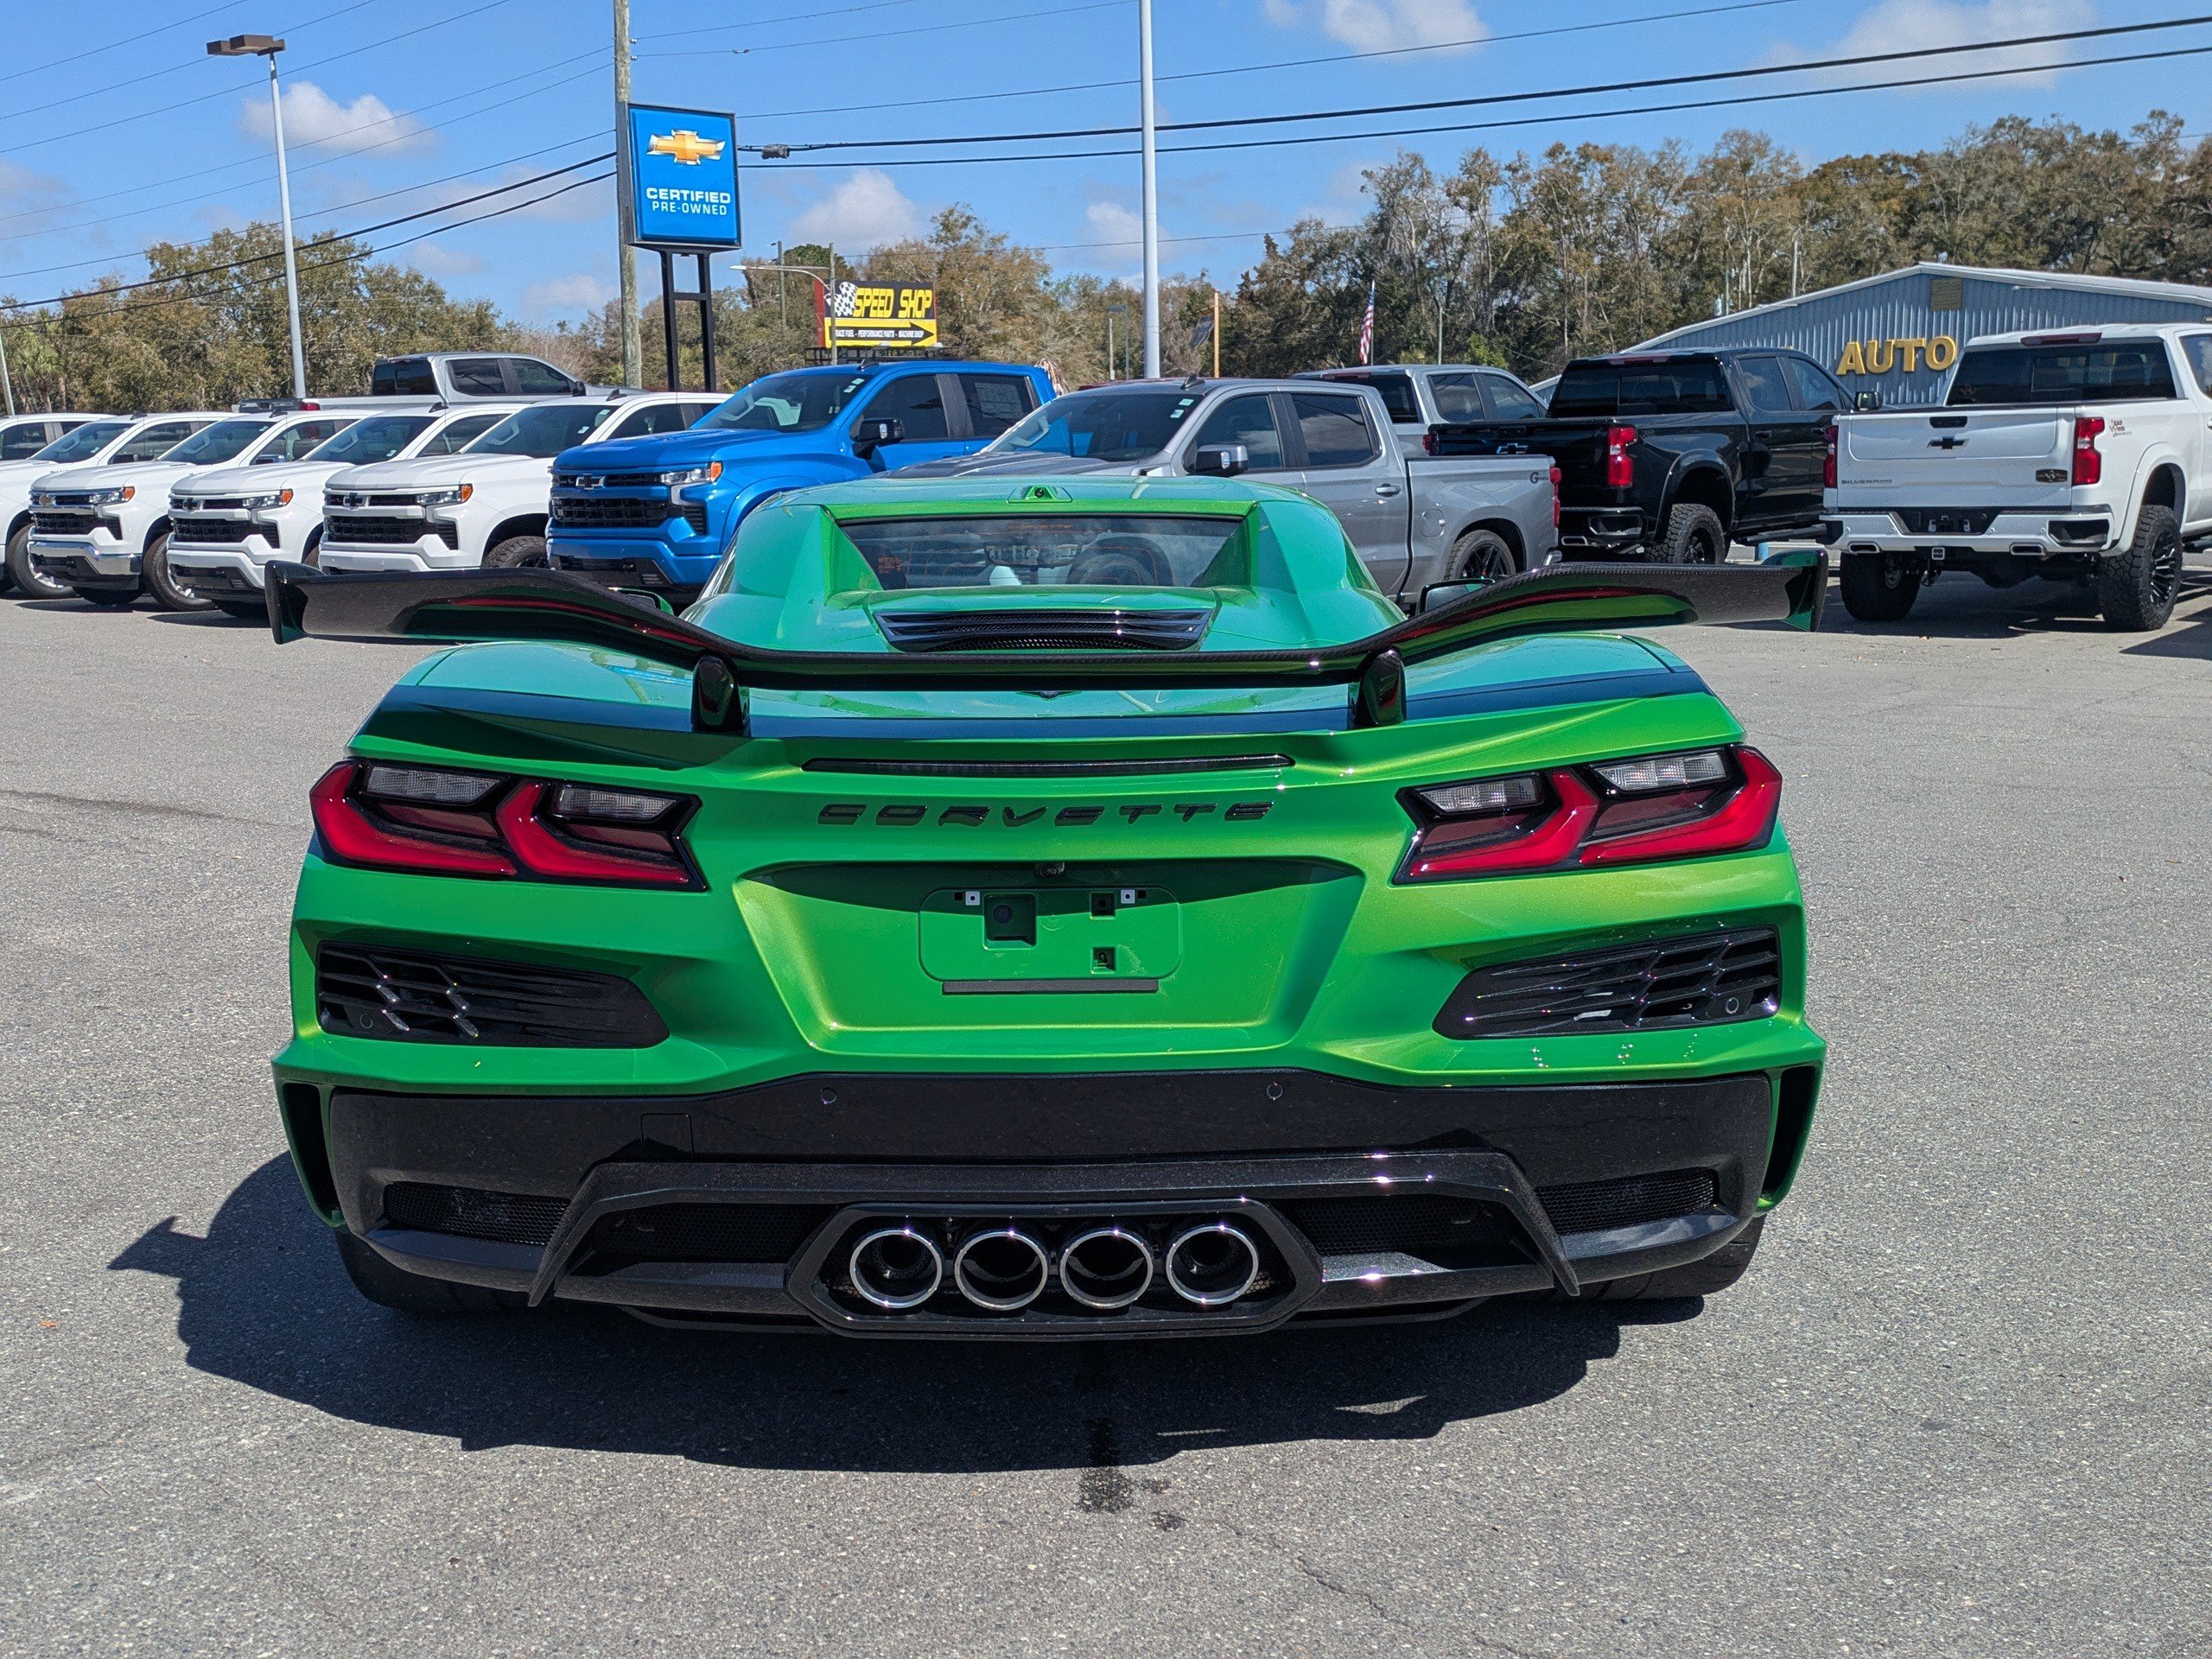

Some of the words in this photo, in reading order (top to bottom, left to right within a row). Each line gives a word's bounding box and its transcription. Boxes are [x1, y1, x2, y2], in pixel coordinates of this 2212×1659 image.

[646, 188, 731, 204] CERTIFIED
[652, 201, 727, 215] PRE-OWNED
[853, 288, 894, 318] SPEED
[898, 289, 932, 318] SHOP
[1835, 334, 1957, 375] AUTO
[817, 801, 1275, 827] CORVETTE
